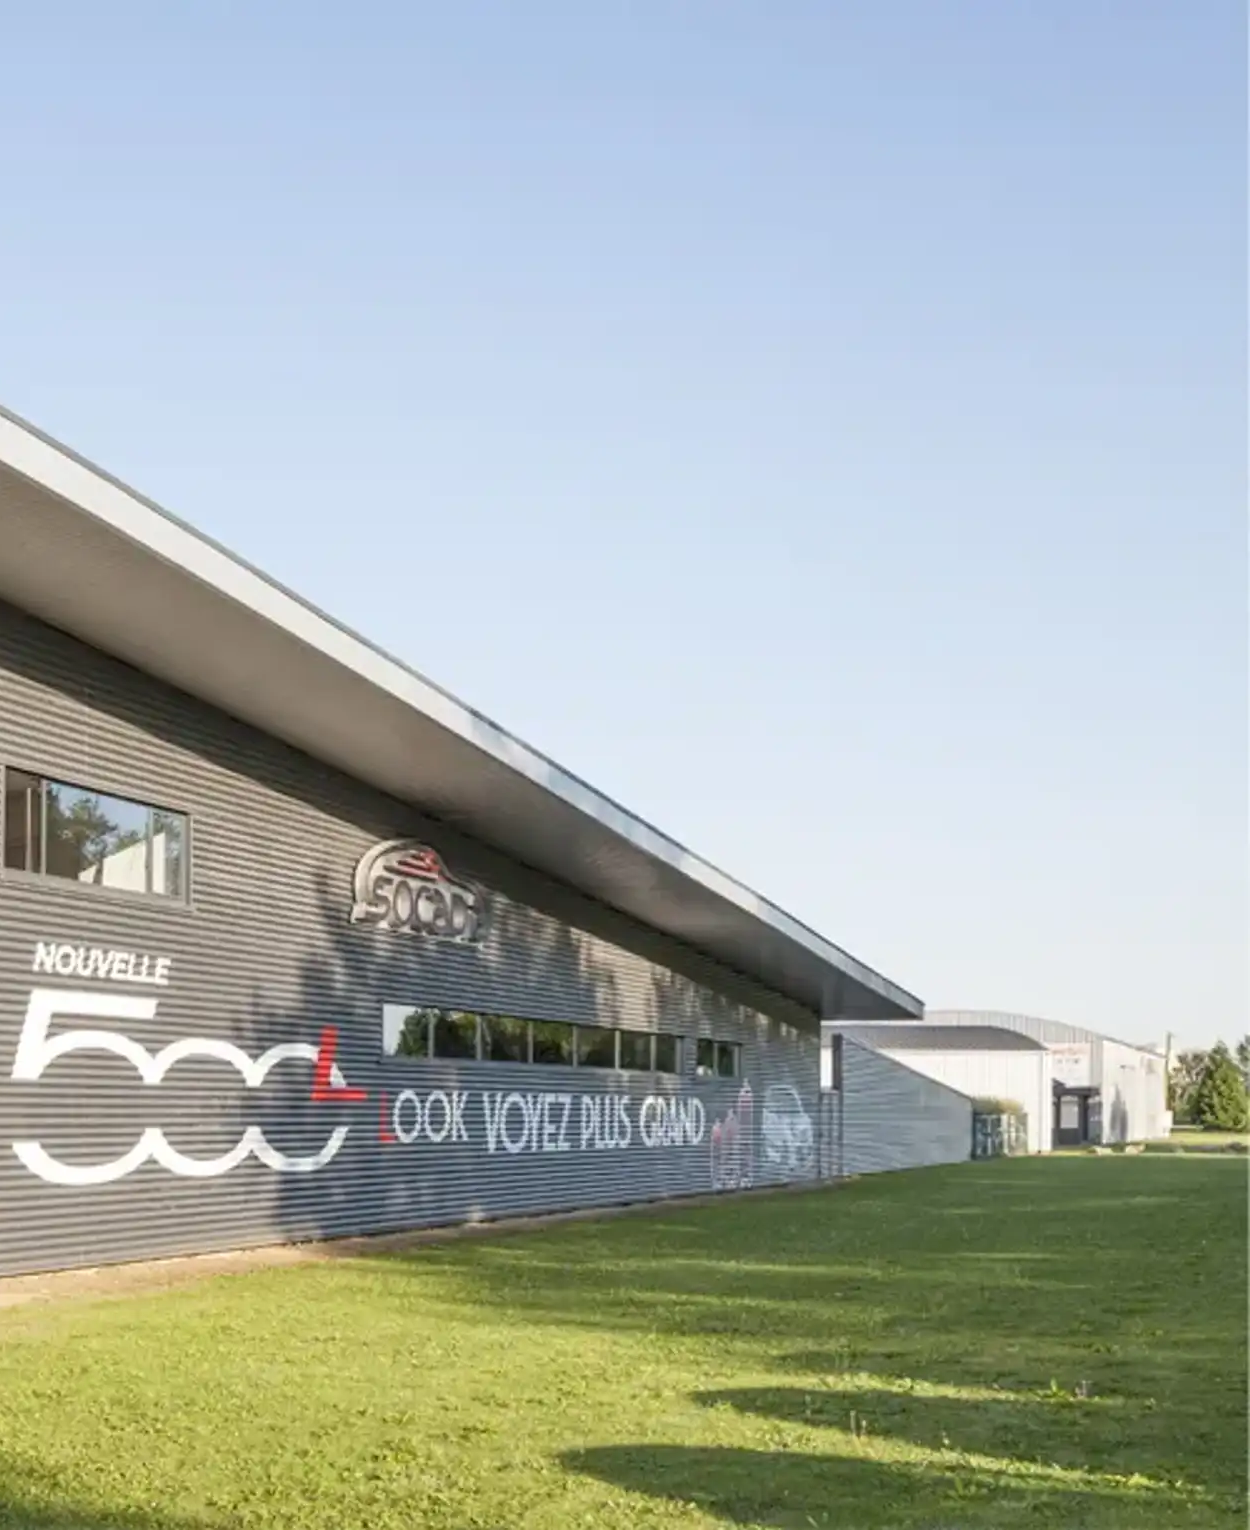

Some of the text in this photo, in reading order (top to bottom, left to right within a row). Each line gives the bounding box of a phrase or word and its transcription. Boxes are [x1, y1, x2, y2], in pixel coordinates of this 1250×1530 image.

[33, 941, 171, 985] NOUVELLE
[379, 1088, 705, 1153] LOOK VOYEZ PLUS GRAND
